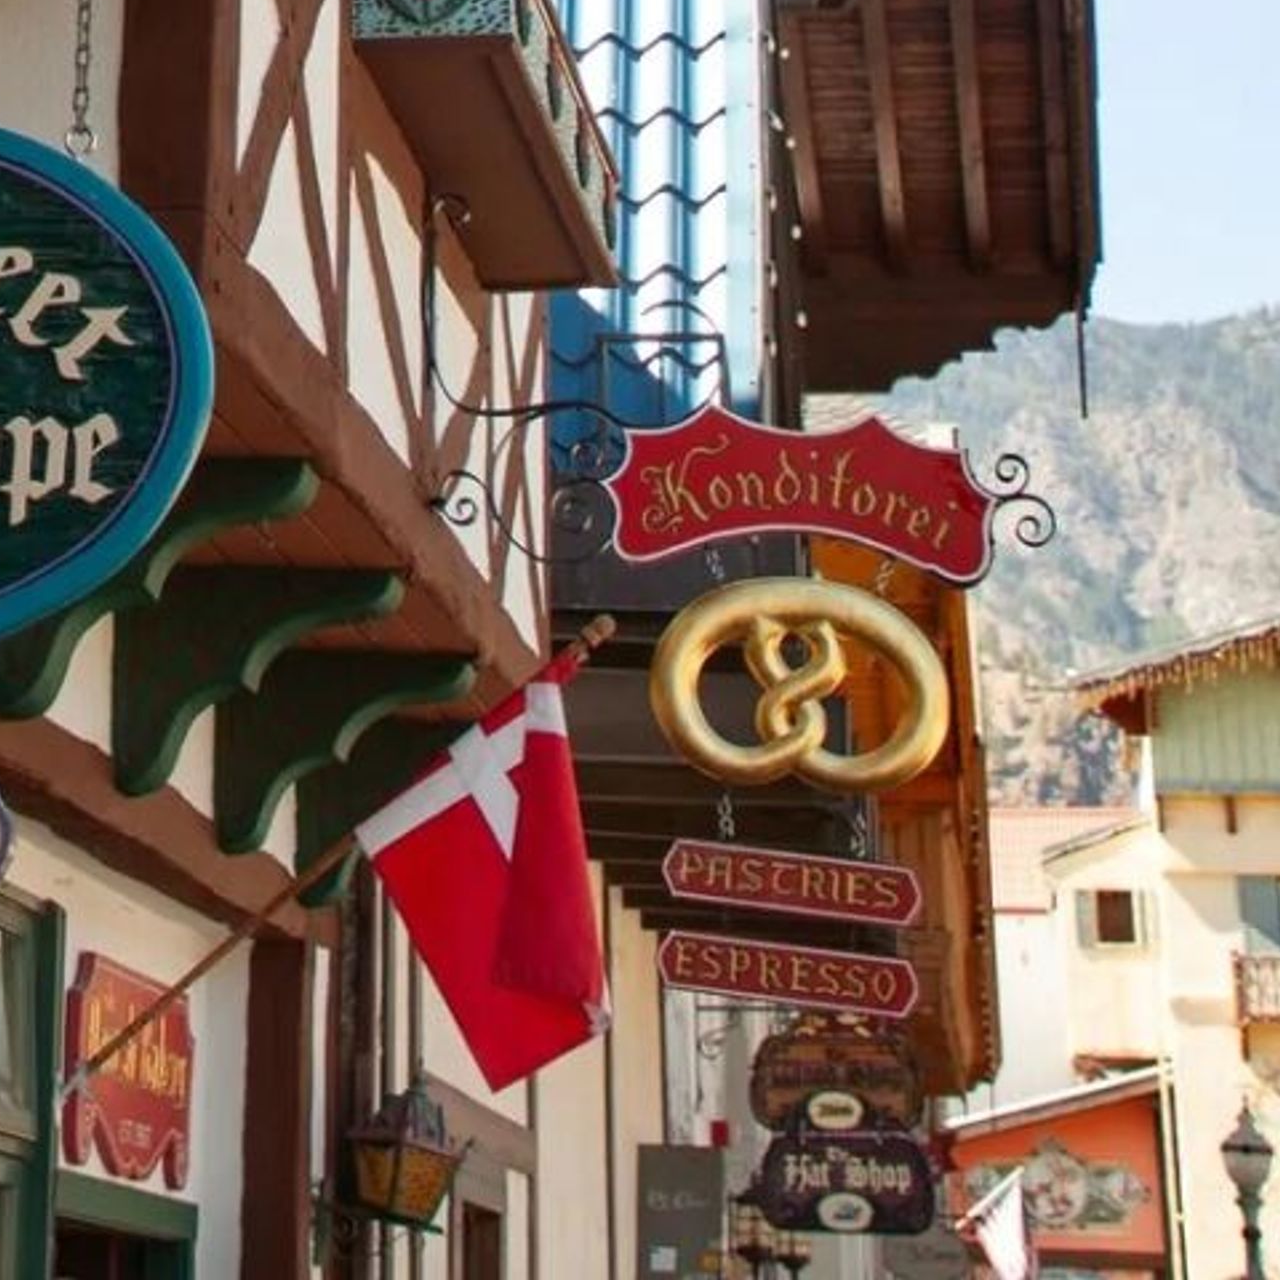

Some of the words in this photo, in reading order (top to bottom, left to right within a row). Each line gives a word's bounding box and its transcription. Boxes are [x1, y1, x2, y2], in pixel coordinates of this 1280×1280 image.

[639, 433, 959, 551] Konditorei
[679, 851, 900, 909] PASTRIES
[674, 941, 898, 1003] ESPRESSO
[783, 1153, 830, 1192] Hat
[845, 1155, 912, 1195] Shop
